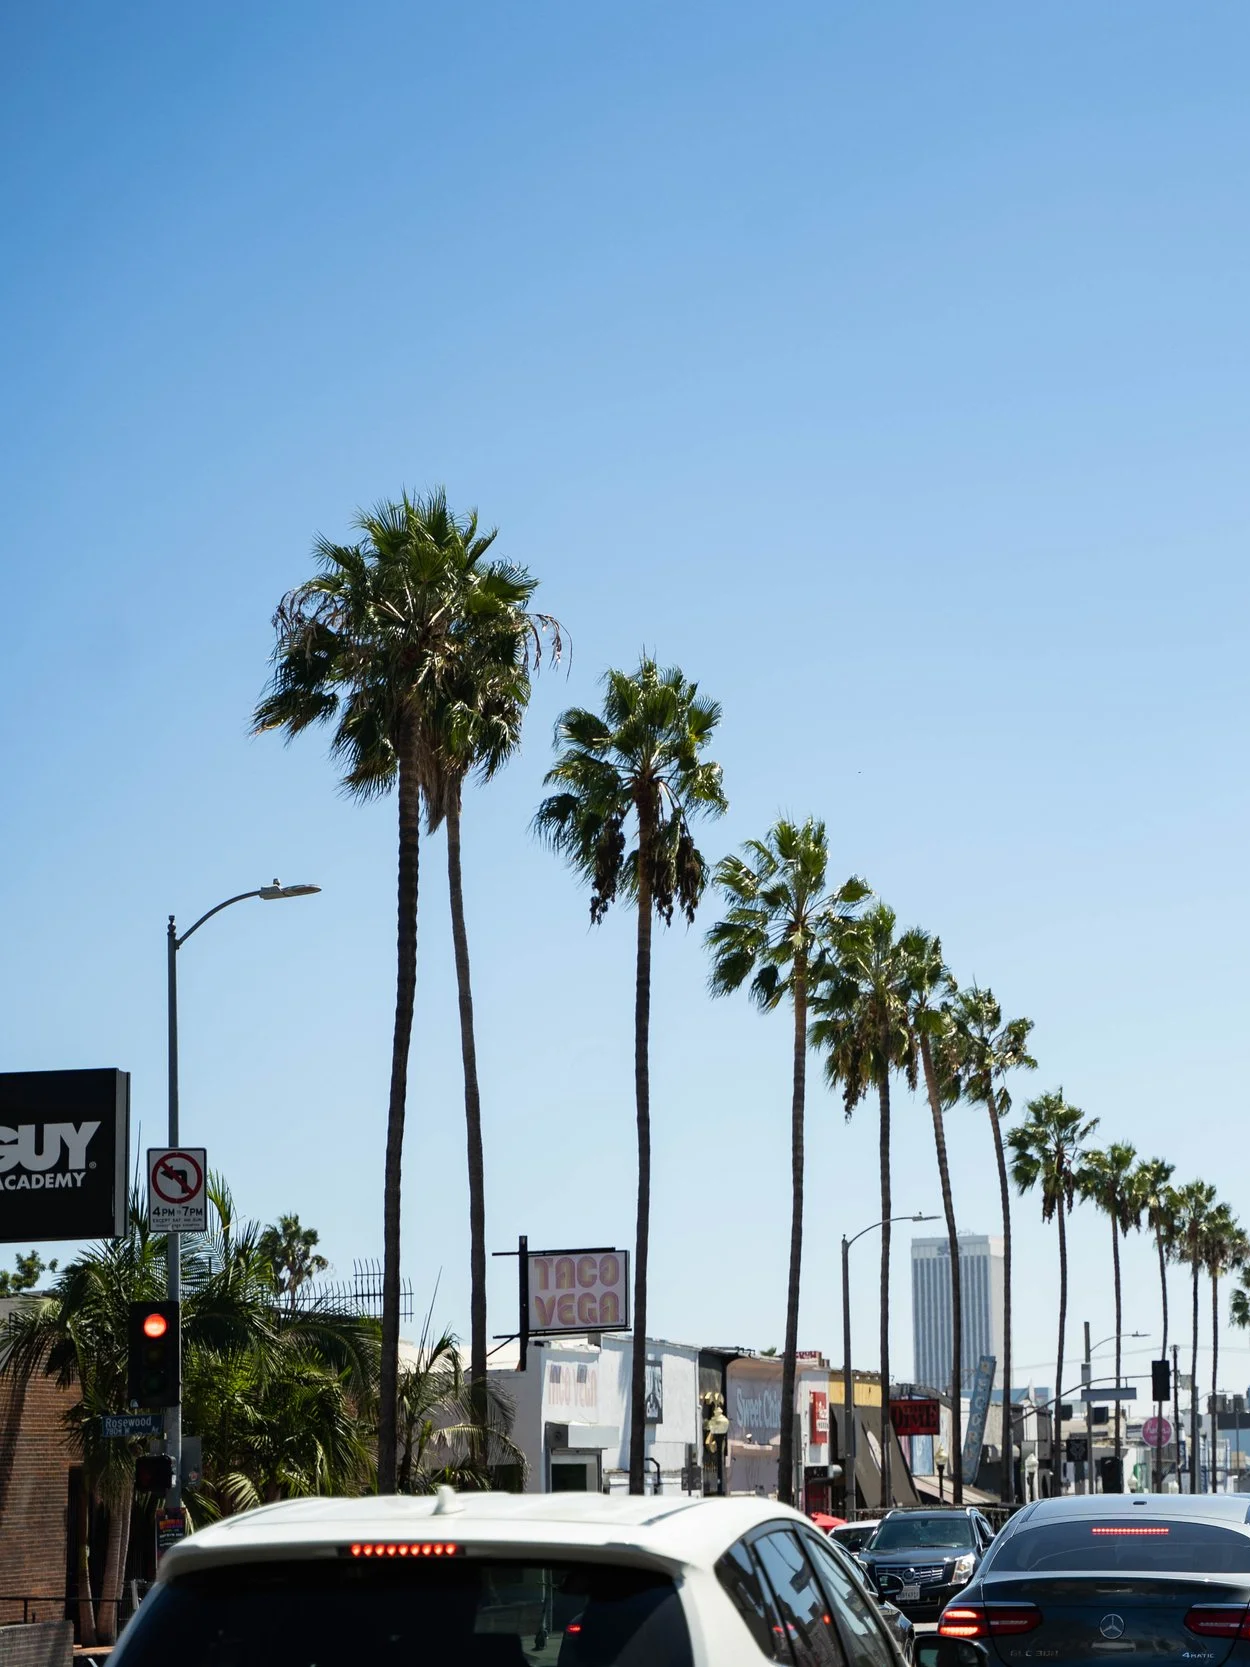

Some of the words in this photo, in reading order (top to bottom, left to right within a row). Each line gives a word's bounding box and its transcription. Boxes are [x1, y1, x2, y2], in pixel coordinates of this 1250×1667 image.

[152, 1206, 175, 1216] 4PM
[181, 1206, 203, 1217] 7PM
[534, 1254, 620, 1290] TACO
[534, 1291, 620, 1327] VEGA
[105, 1416, 152, 1429] Rosewood
[736, 1387, 762, 1428] Sweet
